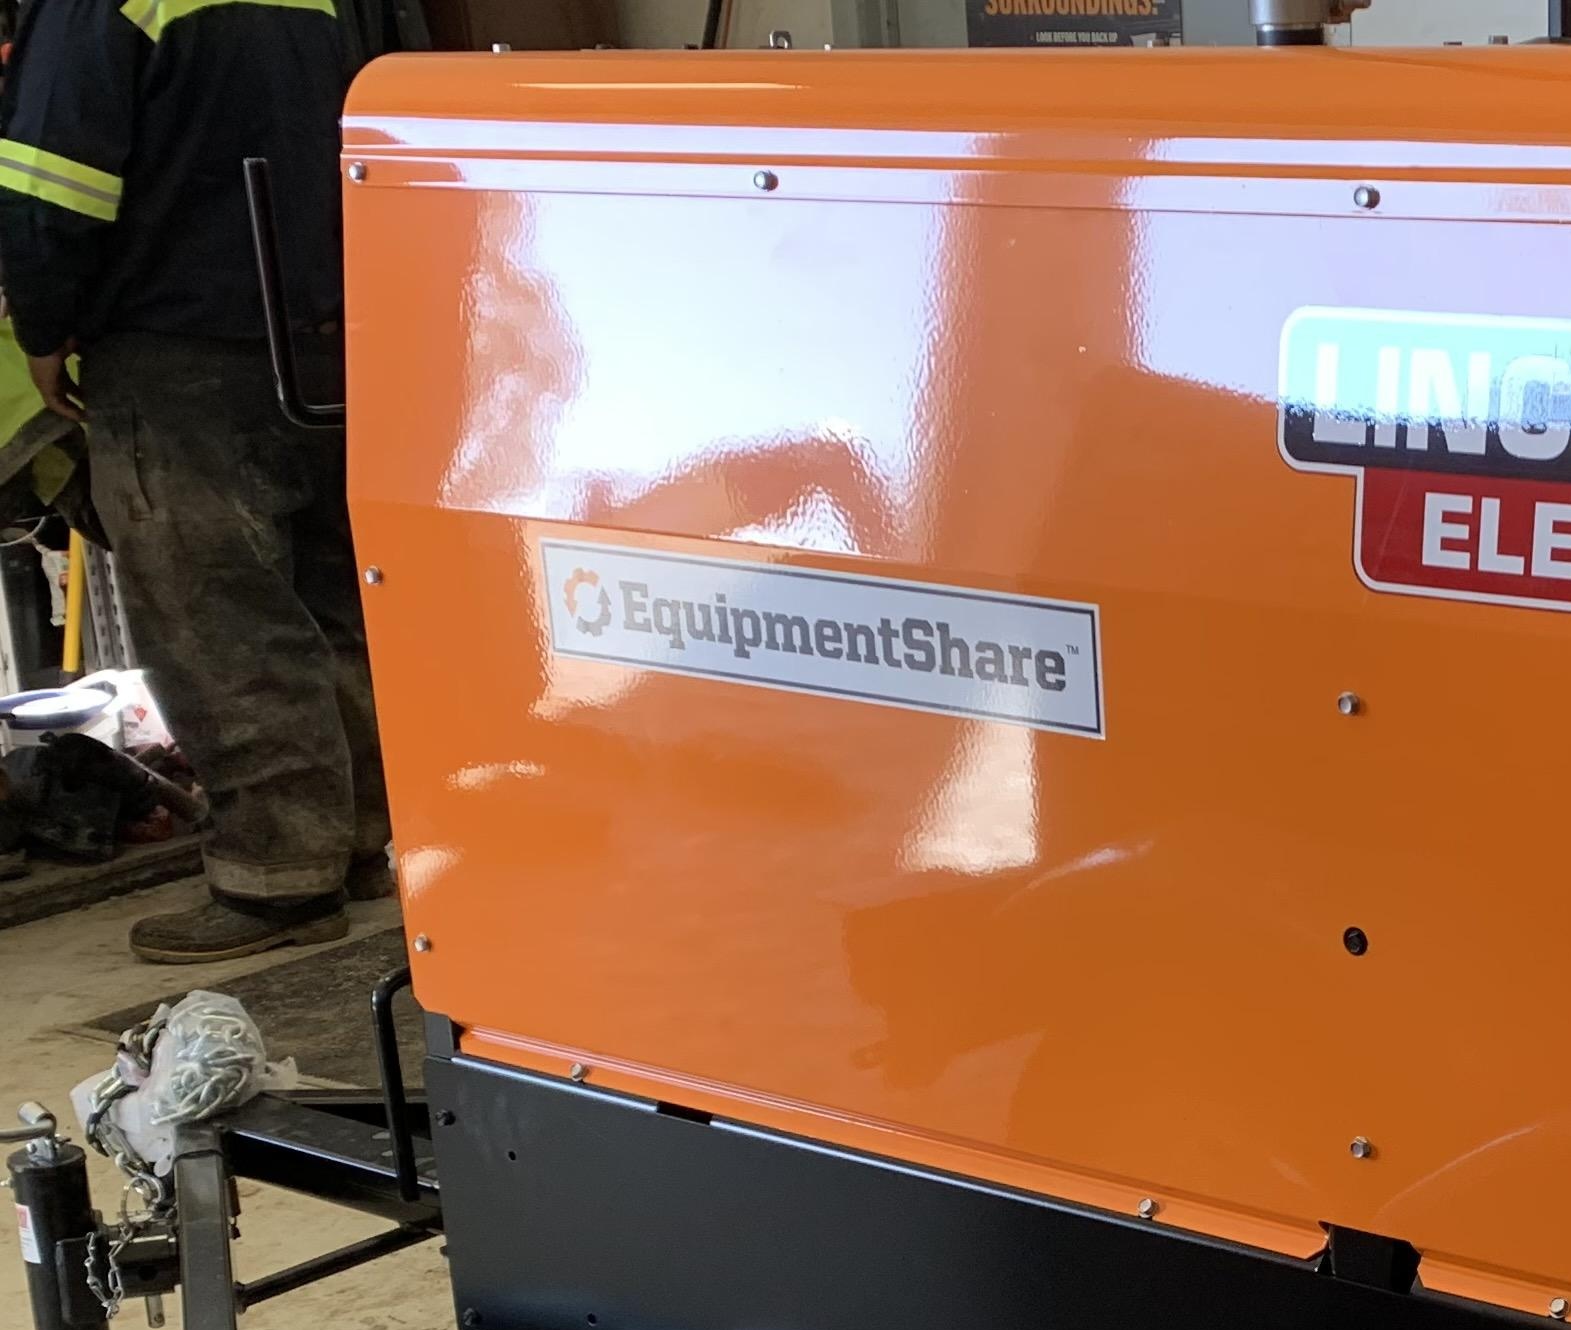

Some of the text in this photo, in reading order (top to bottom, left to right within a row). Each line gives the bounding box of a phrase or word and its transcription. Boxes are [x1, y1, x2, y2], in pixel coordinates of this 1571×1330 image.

[1036, 31, 1118, 43] LOOK BEFORE YOU BACK UP
